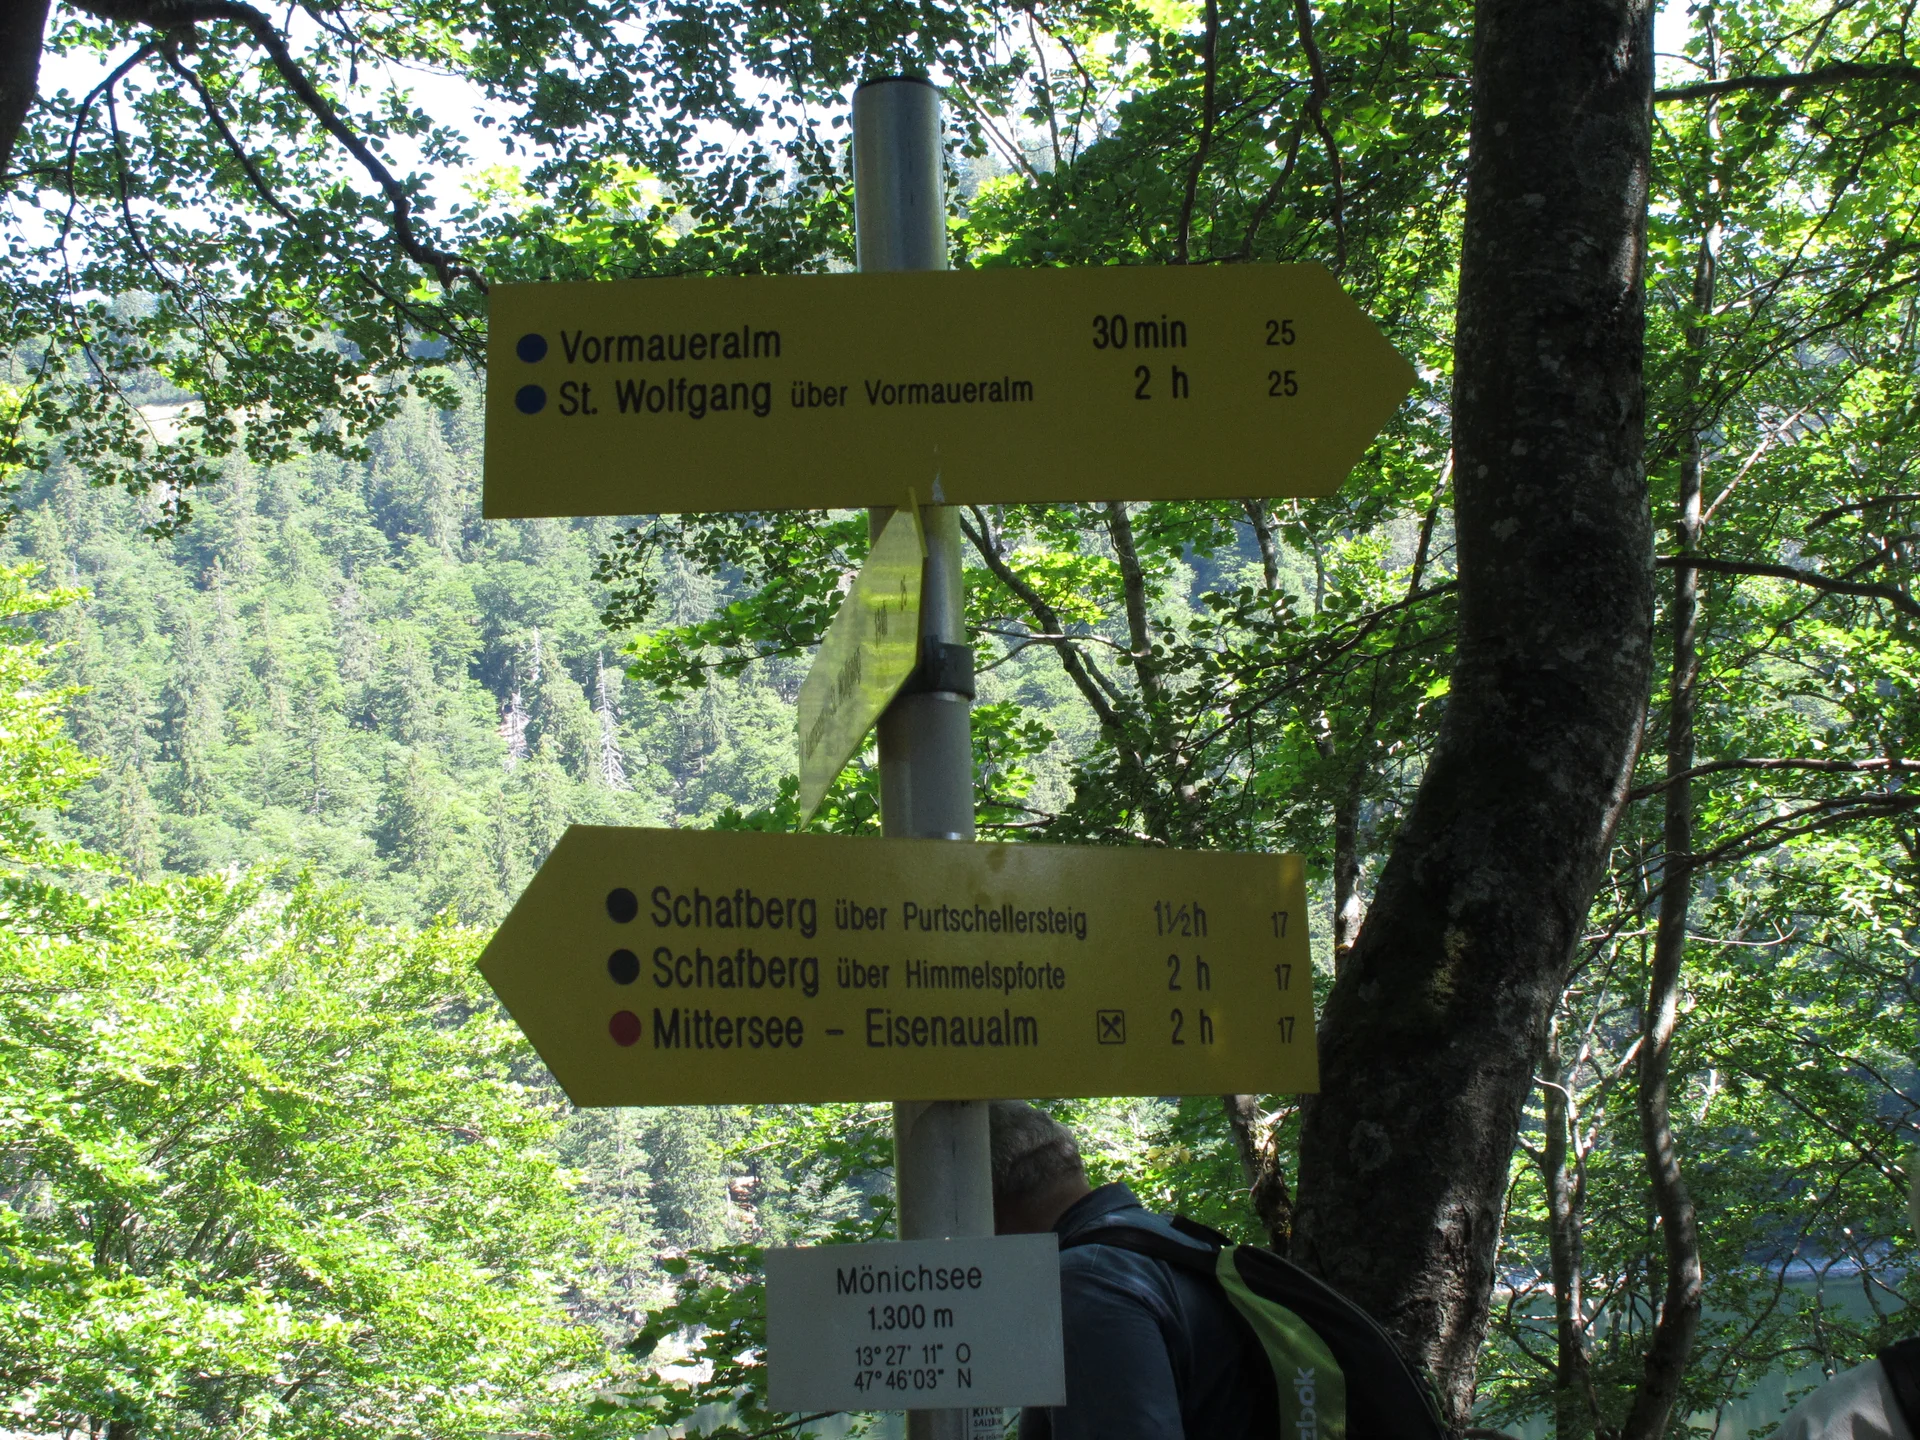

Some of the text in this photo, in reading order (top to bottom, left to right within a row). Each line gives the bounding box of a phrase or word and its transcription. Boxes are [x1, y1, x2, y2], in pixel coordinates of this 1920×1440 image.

[560, 324, 782, 365] Vormaueralm
[1265, 319, 1297, 347] 25
[558, 364, 1299, 420] St. Wolfgang über Vormaueralm 2 h 25
[650, 885, 818, 939] Schafberg
[834, 898, 889, 931] über
[902, 901, 1088, 941] Purtschellersteig
[1270, 910, 1290, 939] 17
[652, 946, 1293, 998] Schafberg über Himmelspforte 2 h 17
[653, 1007, 804, 1050] Mittersee
[865, 1007, 1038, 1048] Eisenaualm
[1170, 1007, 1186, 1046] 2
[1198, 1008, 1214, 1045] h
[1277, 1015, 1297, 1045] 17
[836, 1264, 983, 1295] Mönichsee
[867, 1303, 954, 1331] 1.300 m
[957, 1368, 972, 1389] N
